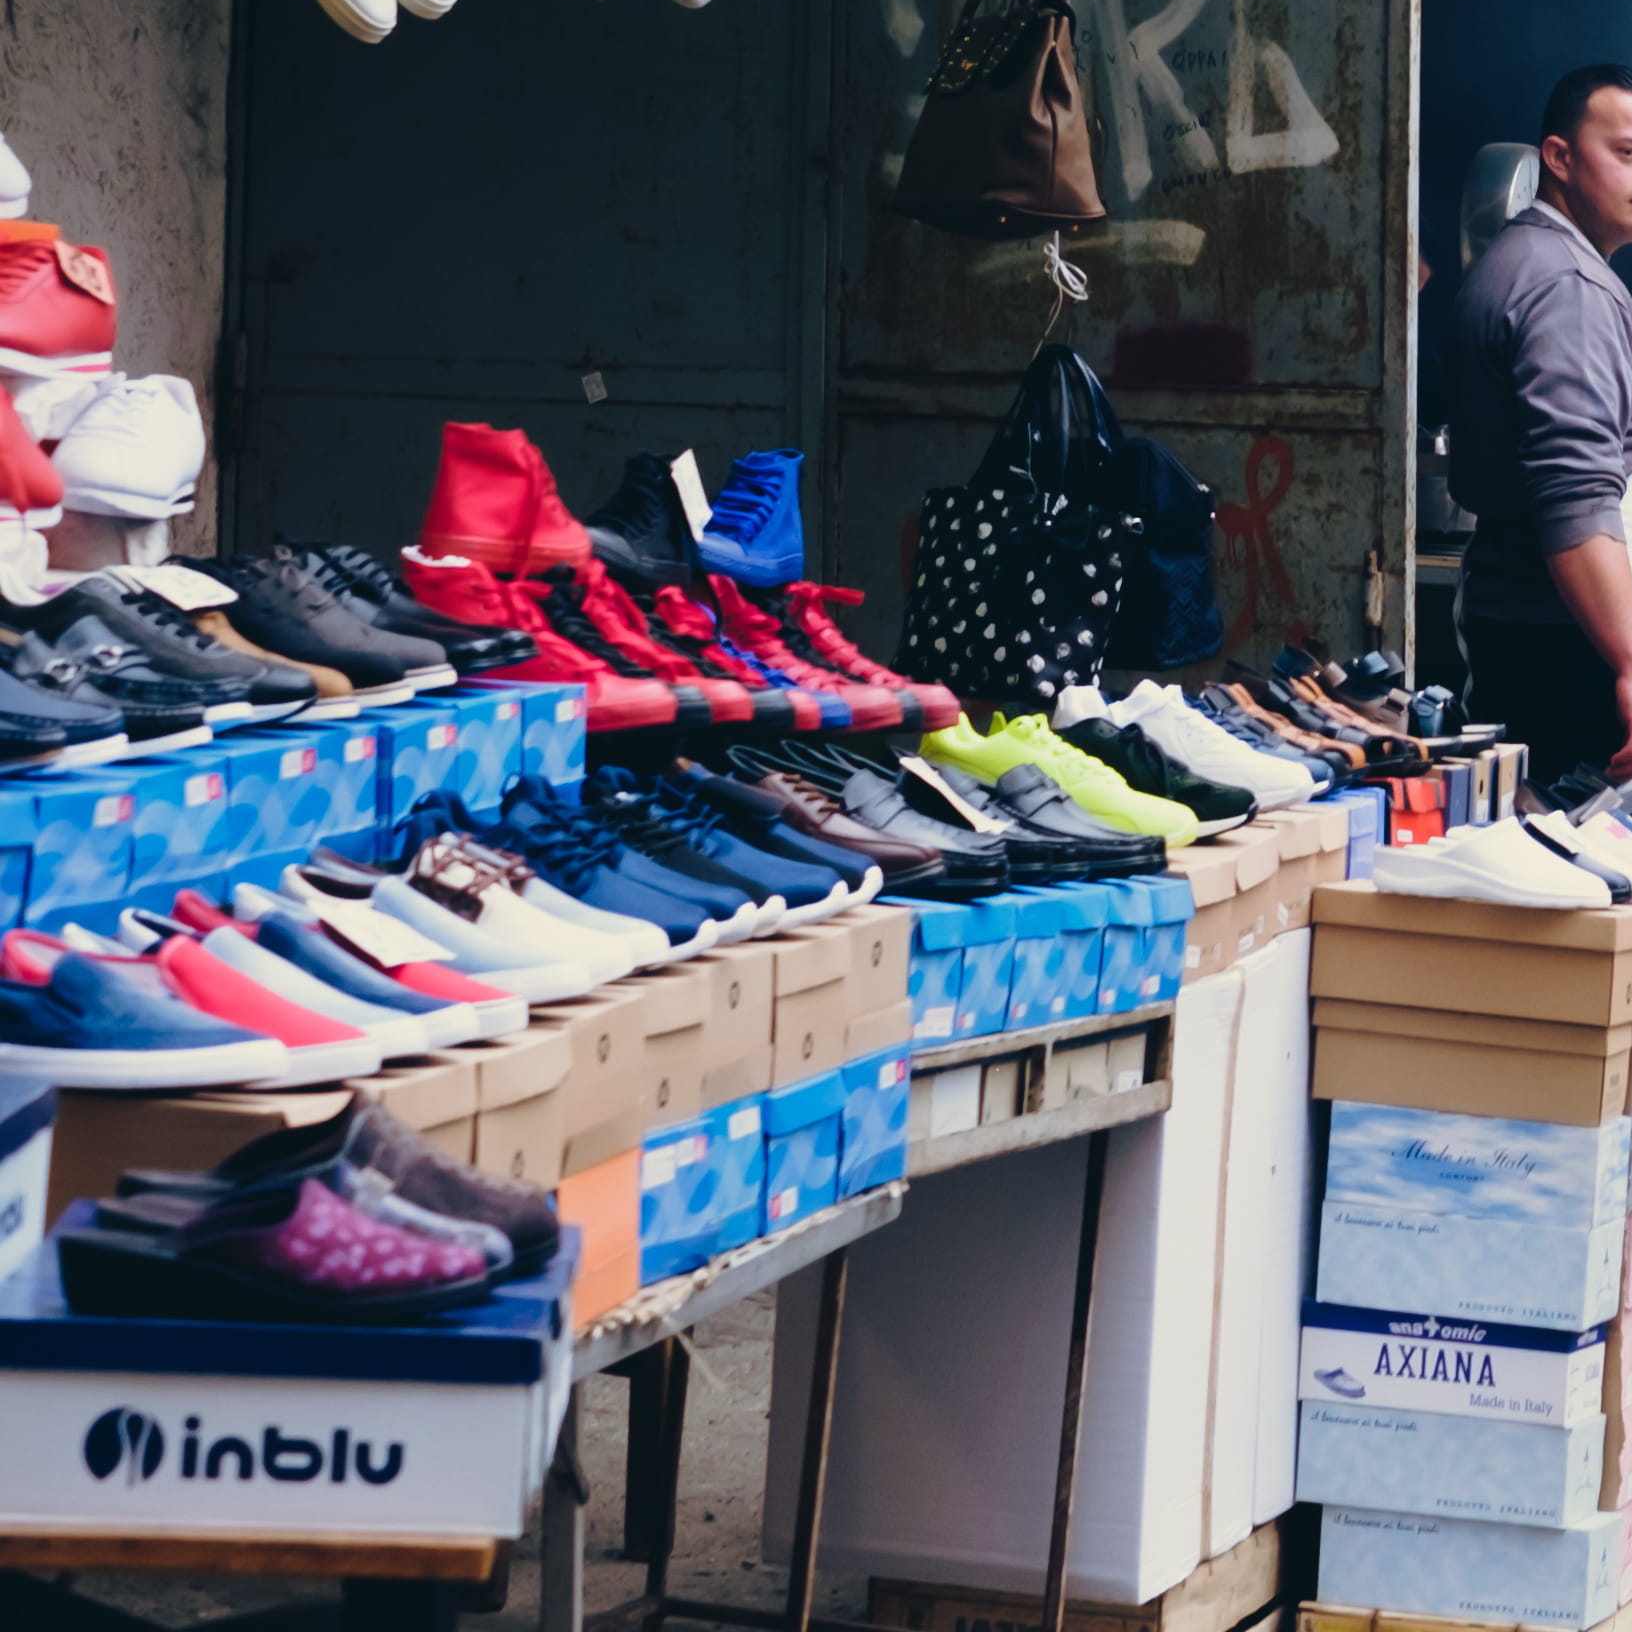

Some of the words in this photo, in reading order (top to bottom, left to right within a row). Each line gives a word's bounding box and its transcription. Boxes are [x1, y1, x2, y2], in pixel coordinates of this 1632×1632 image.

[1390, 1139, 1454, 1163] Made
[1455, 1152, 1476, 1166] in
[1485, 1148, 1537, 1178] Italy
[1373, 1342, 1497, 1387] AXIANA
[1469, 1392, 1505, 1410] Made
[1508, 1395, 1520, 1411] in
[1524, 1395, 1554, 1415] Italy
[181, 1415, 405, 1485] inblu
